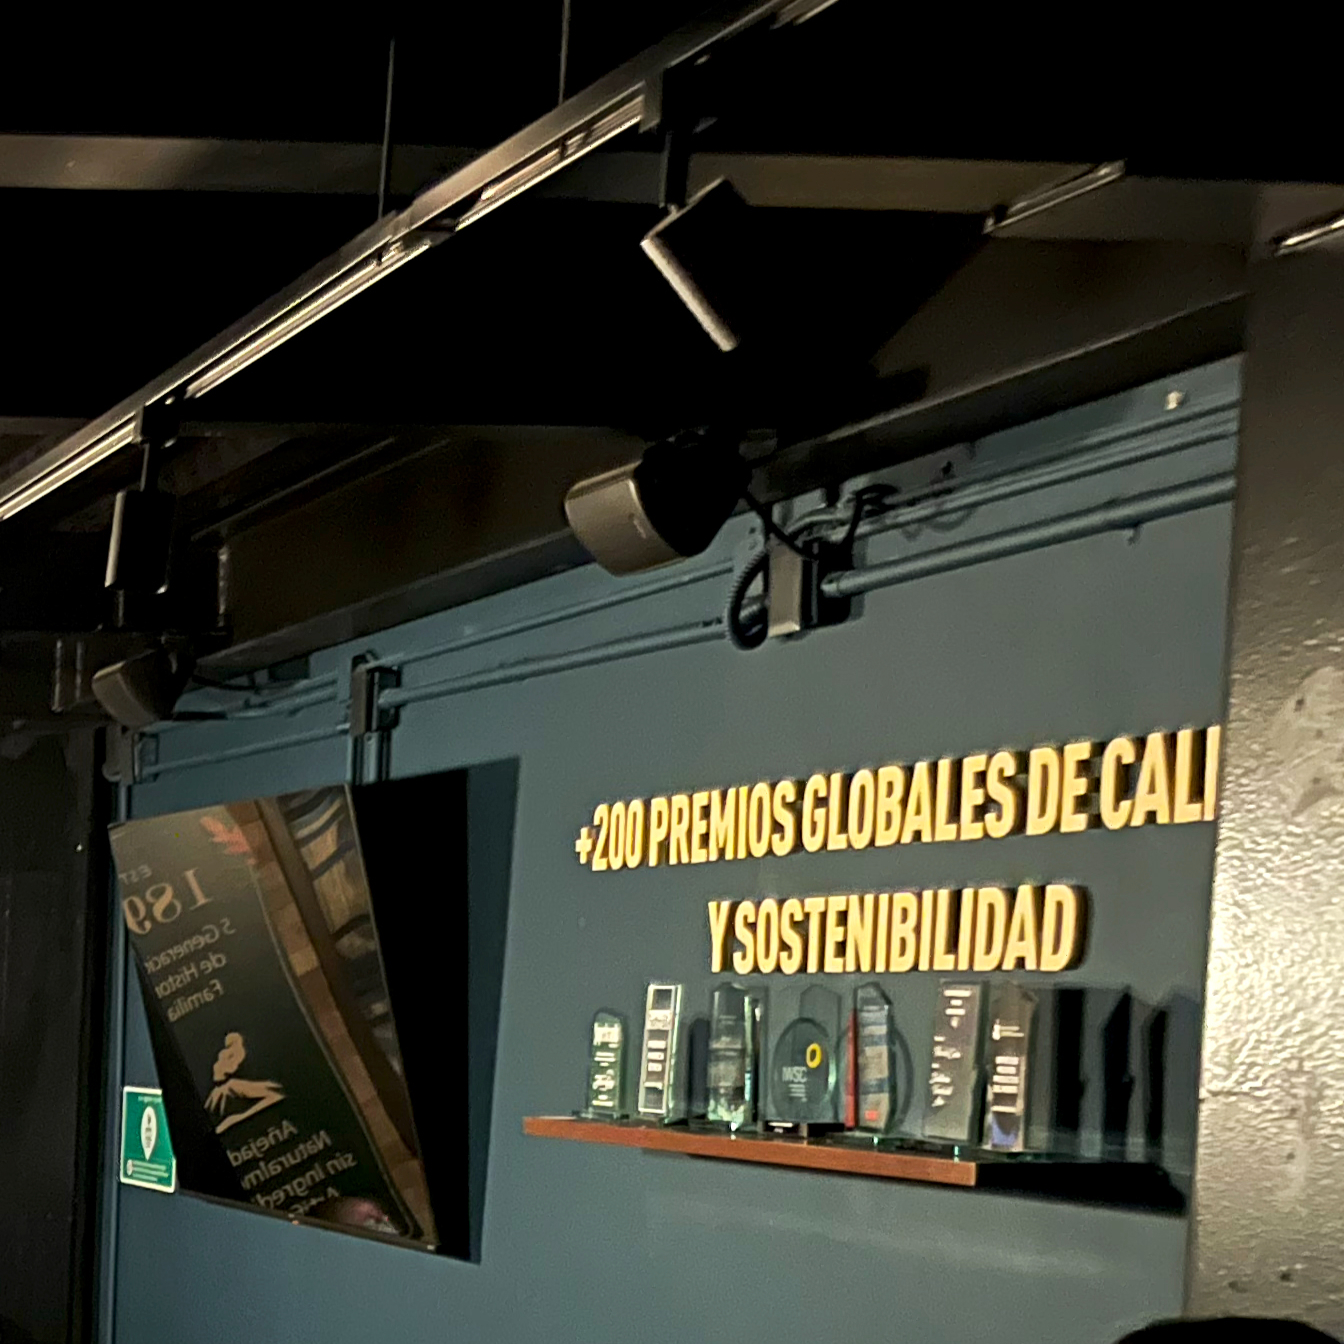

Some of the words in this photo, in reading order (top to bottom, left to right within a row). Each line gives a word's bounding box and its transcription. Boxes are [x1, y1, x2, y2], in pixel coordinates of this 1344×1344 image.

[575, 799, 645, 872] +200
[648, 780, 797, 867] PREMIOS
[801, 751, 1017, 853] GLOBALES
[1025, 741, 1091, 836] DE
[708, 900, 730, 973] Y
[733, 884, 1077, 975] SOSTENIBILIDAD
